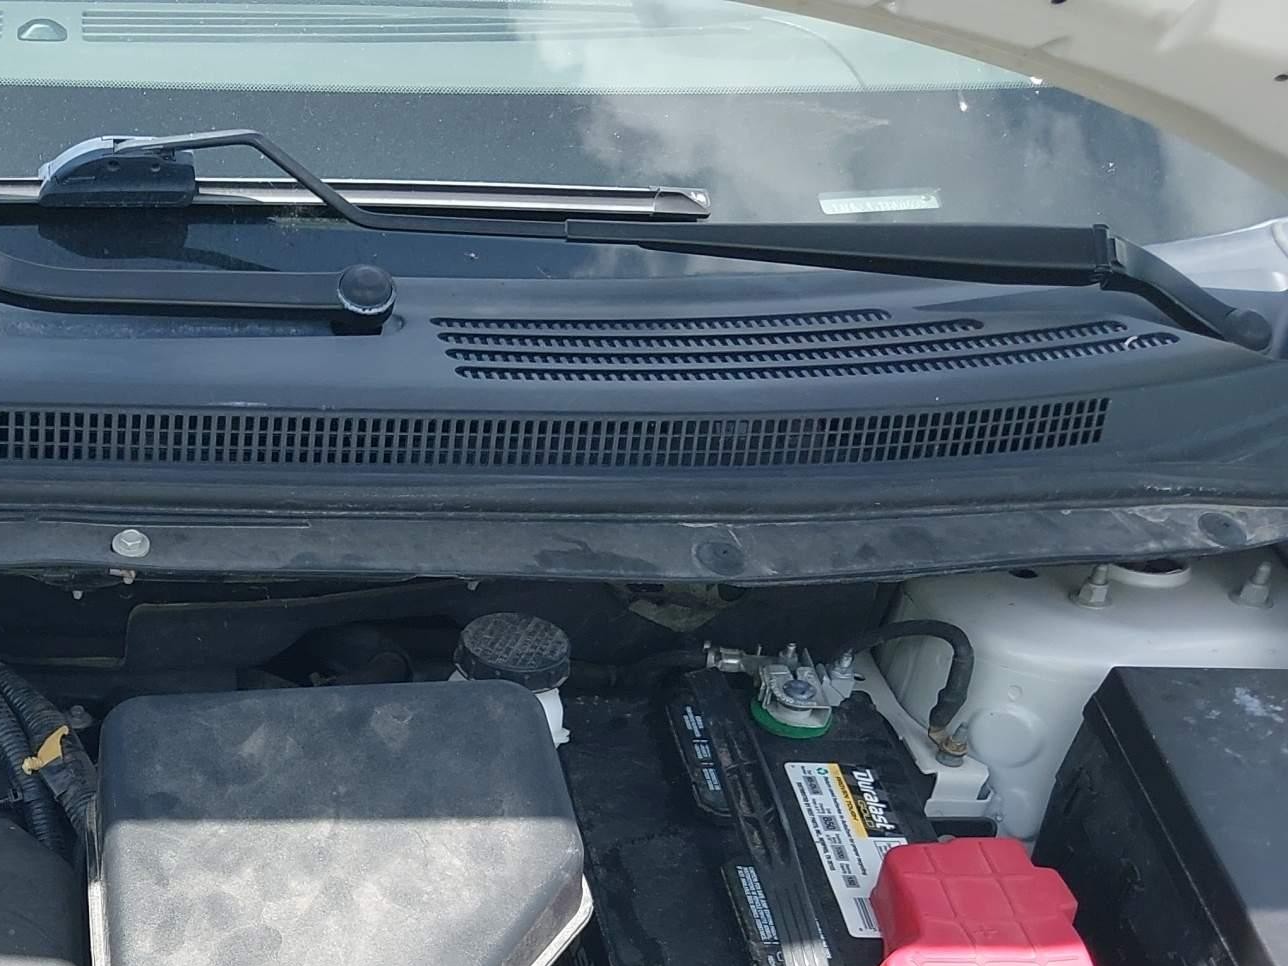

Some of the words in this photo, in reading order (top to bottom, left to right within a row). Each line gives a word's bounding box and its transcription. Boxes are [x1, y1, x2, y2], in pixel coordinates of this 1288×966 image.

[852, 769, 896, 830] Duralast
[857, 799, 875, 828] GOLD
[822, 816, 836, 830] 850
